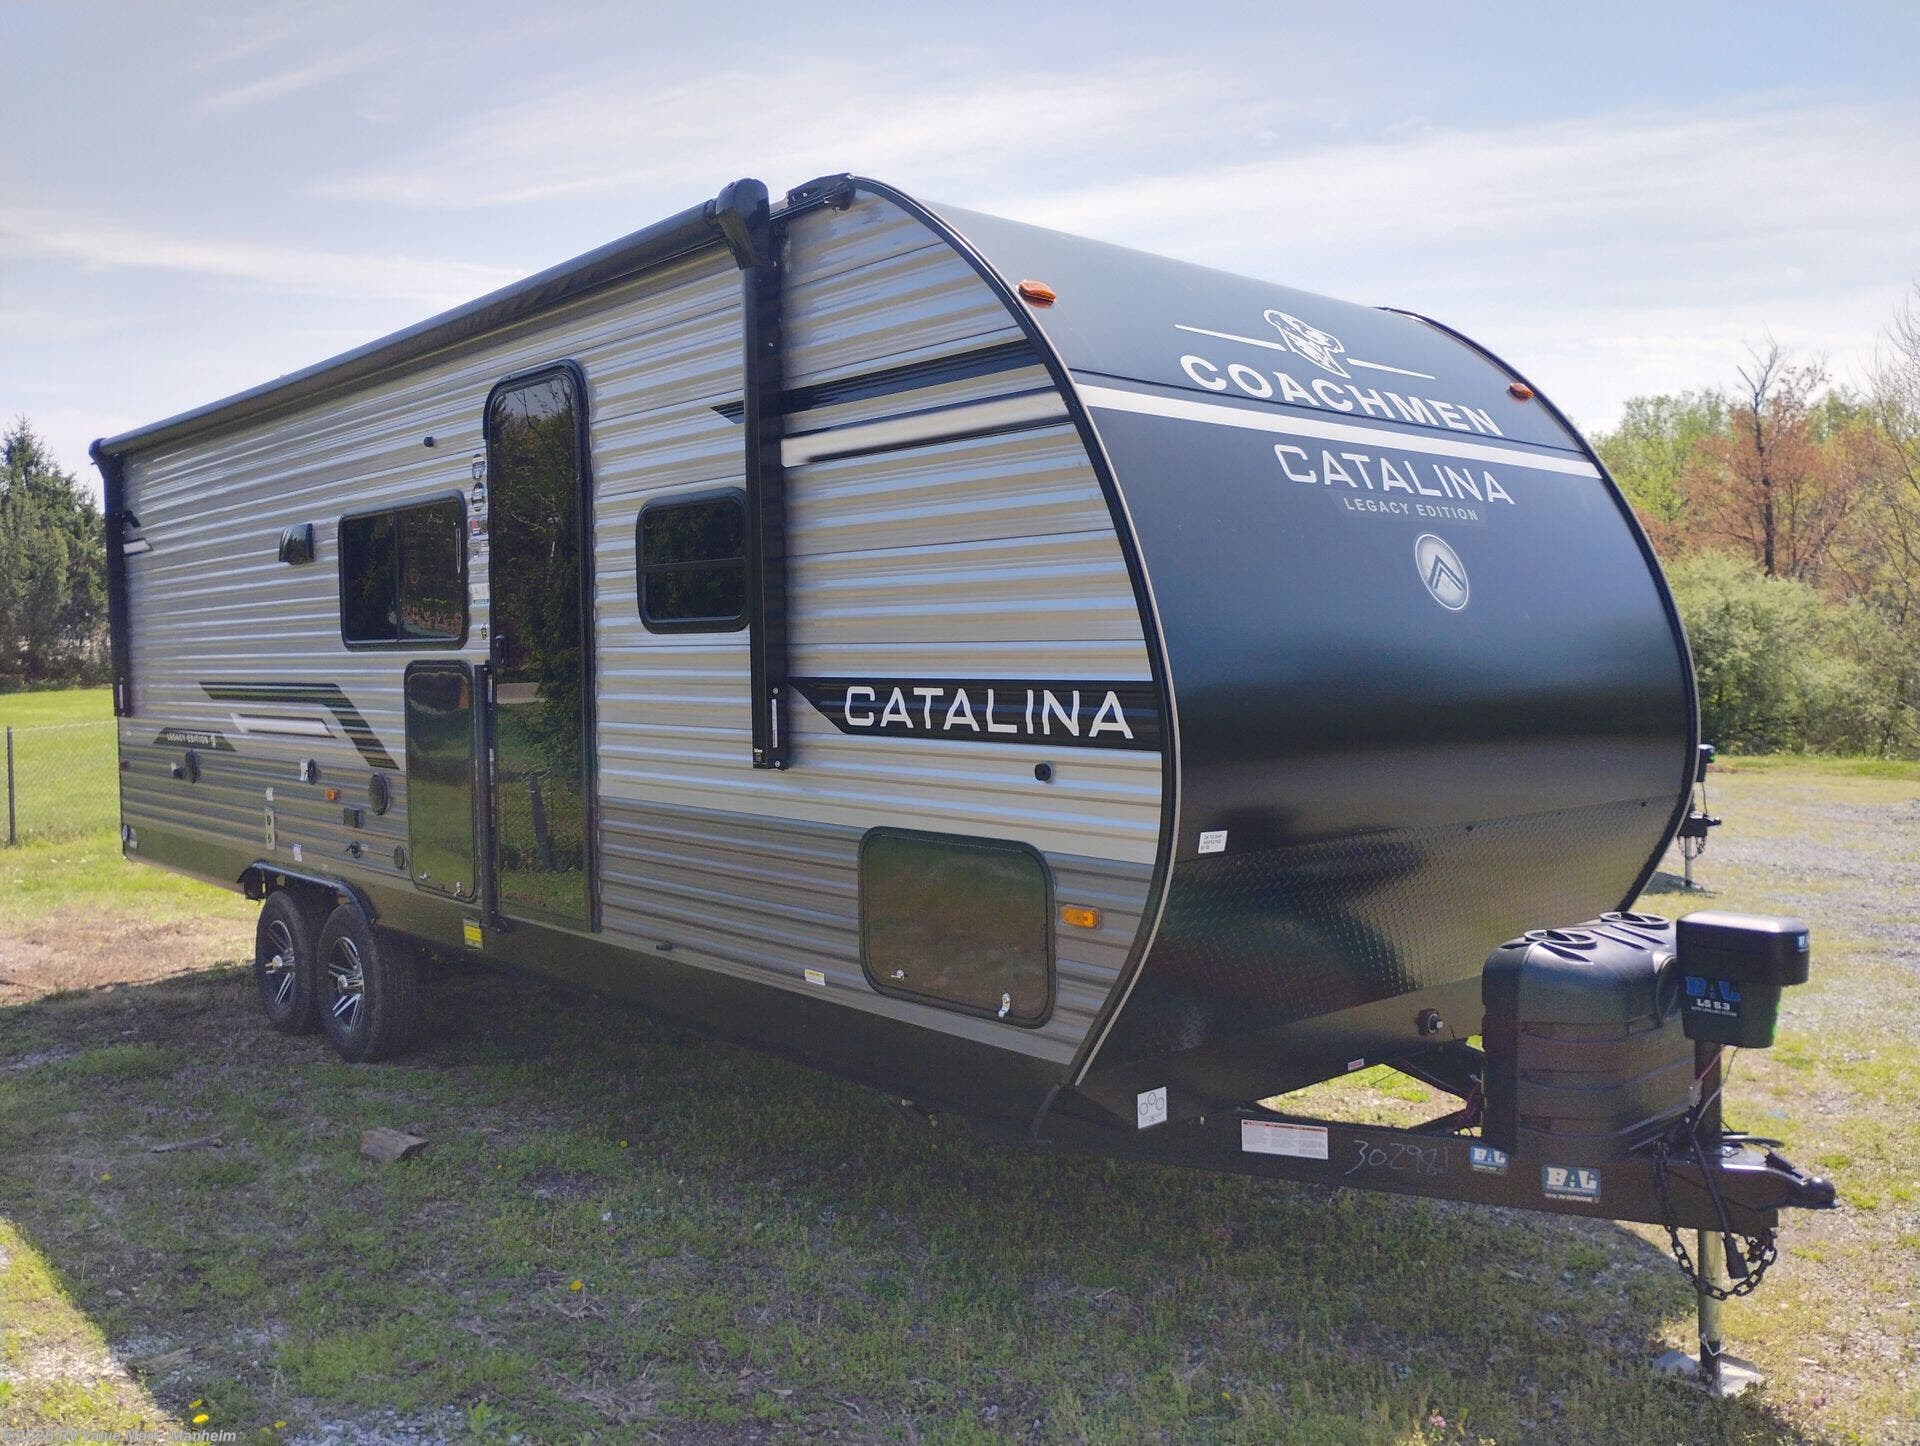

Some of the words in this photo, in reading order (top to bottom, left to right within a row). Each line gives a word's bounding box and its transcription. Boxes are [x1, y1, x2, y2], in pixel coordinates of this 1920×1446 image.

[1180, 354, 1504, 437] COACHMEN
[1273, 443, 1515, 505] CATALINA
[1343, 497, 1409, 515] LEGACY
[1415, 504, 1479, 521] EDITION
[844, 686, 1135, 740] CATALINA
[1473, 1147, 1506, 1164] BAL
[1546, 1166, 1598, 1189] BAL
